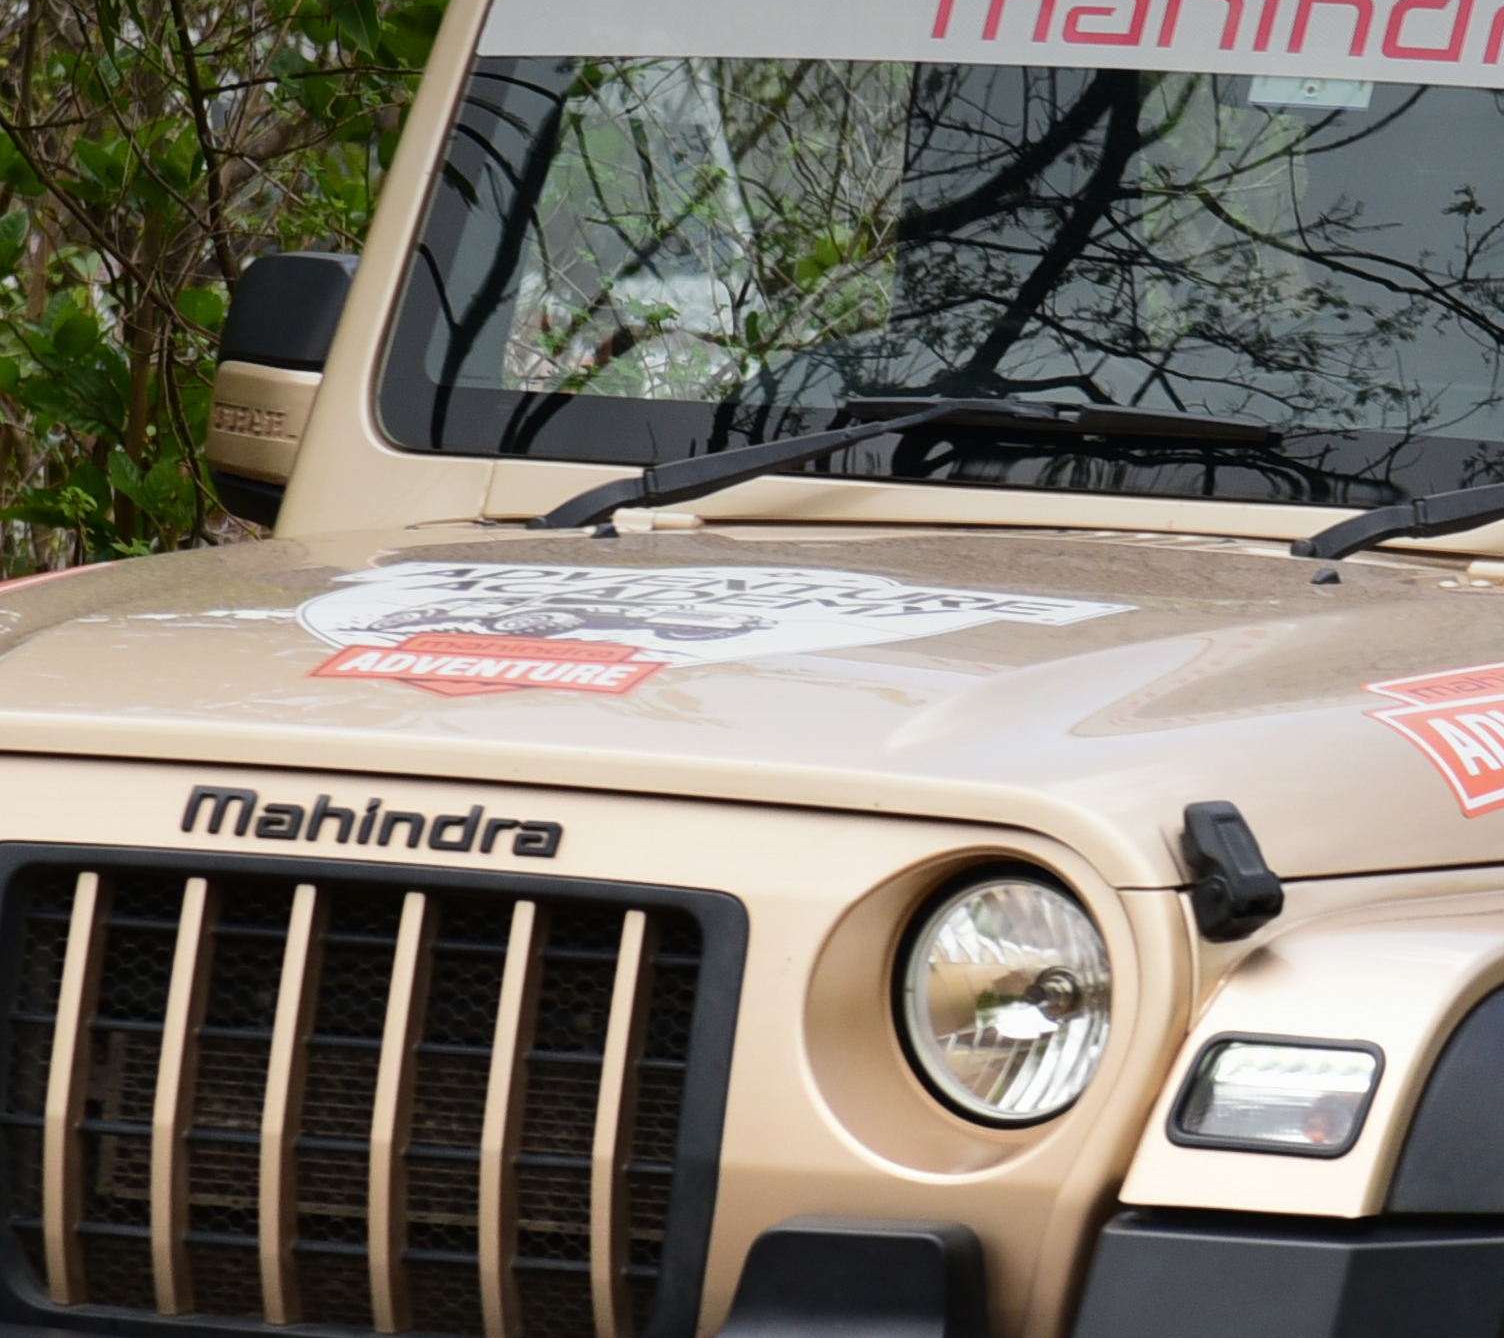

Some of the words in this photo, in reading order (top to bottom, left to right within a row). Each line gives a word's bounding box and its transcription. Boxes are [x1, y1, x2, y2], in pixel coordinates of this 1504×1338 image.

[393, 567, 1079, 616] ADVENTURE
[422, 637, 621, 660] mahindra
[336, 649, 640, 688] ADVENTURE
